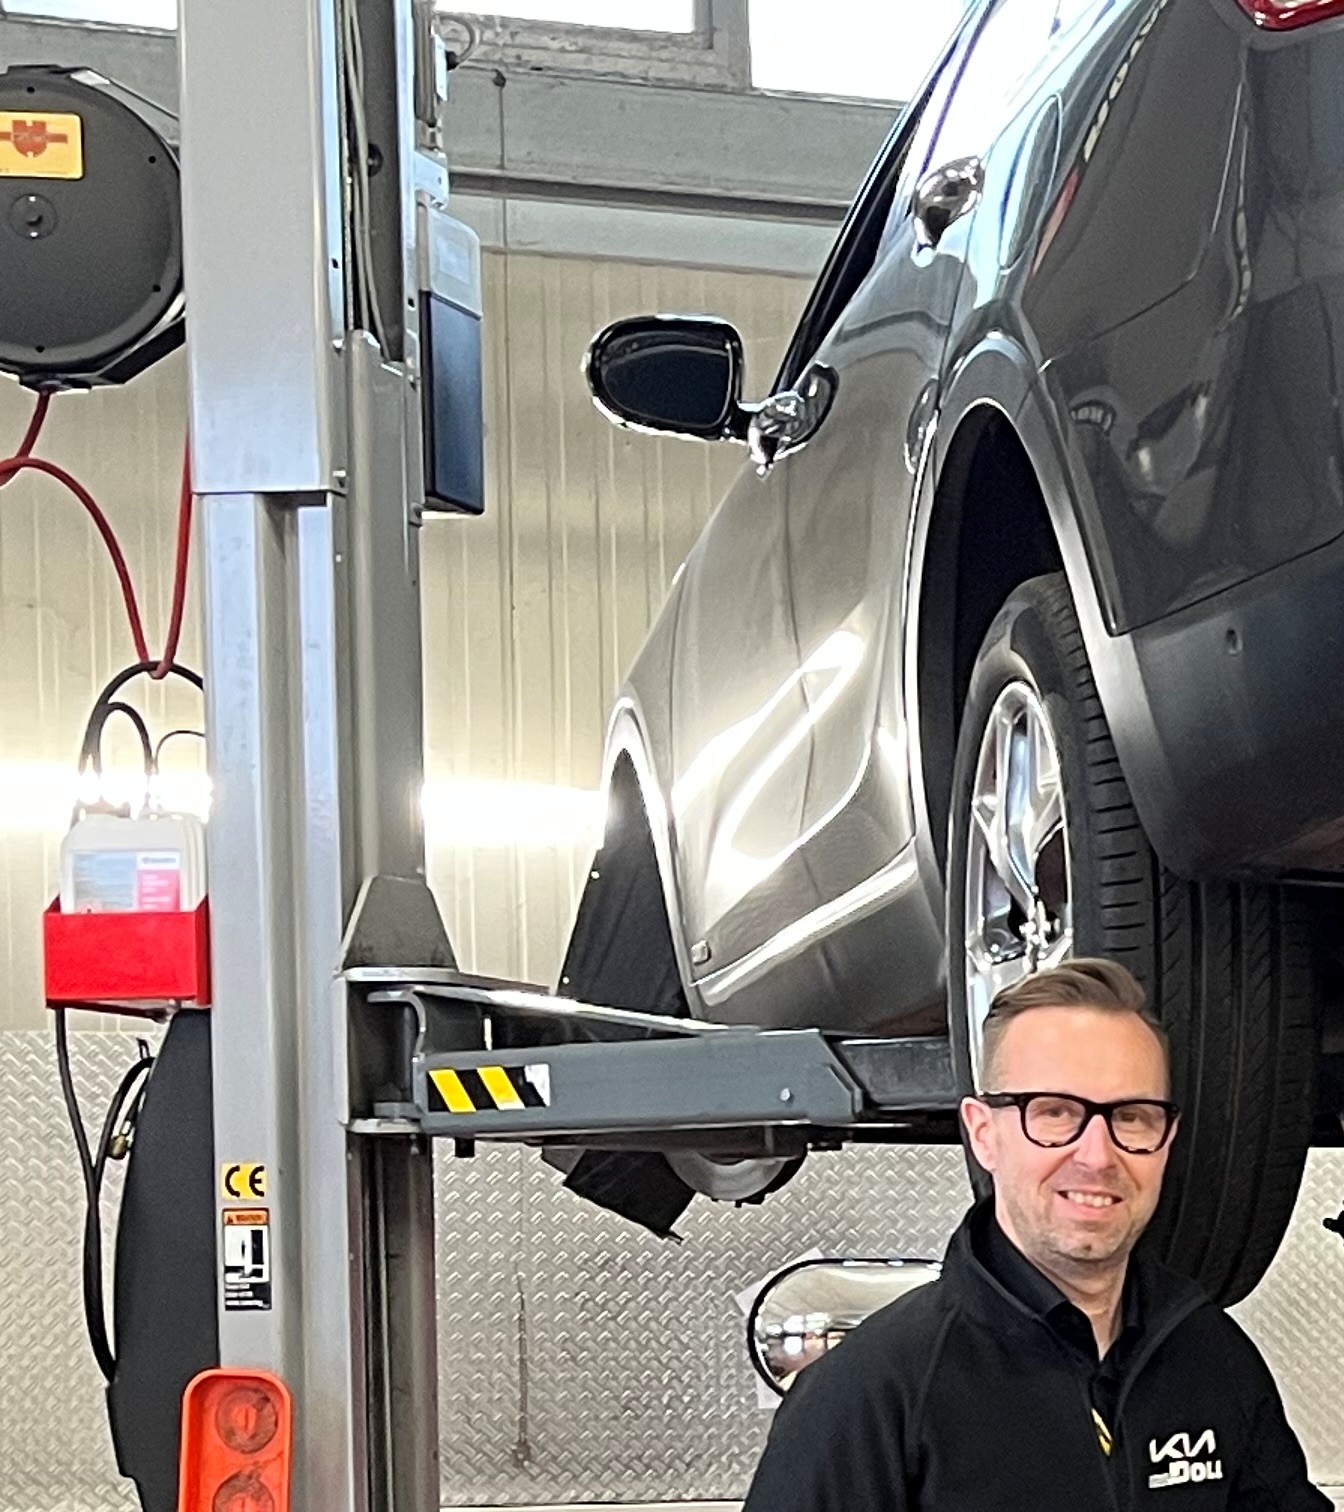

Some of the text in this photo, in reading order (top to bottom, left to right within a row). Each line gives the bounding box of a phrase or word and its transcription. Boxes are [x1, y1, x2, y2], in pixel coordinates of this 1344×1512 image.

[224, 1165, 265, 1198] CE
[1149, 1428, 1217, 1464] KIA
[1159, 1459, 1223, 1486] DOLL
